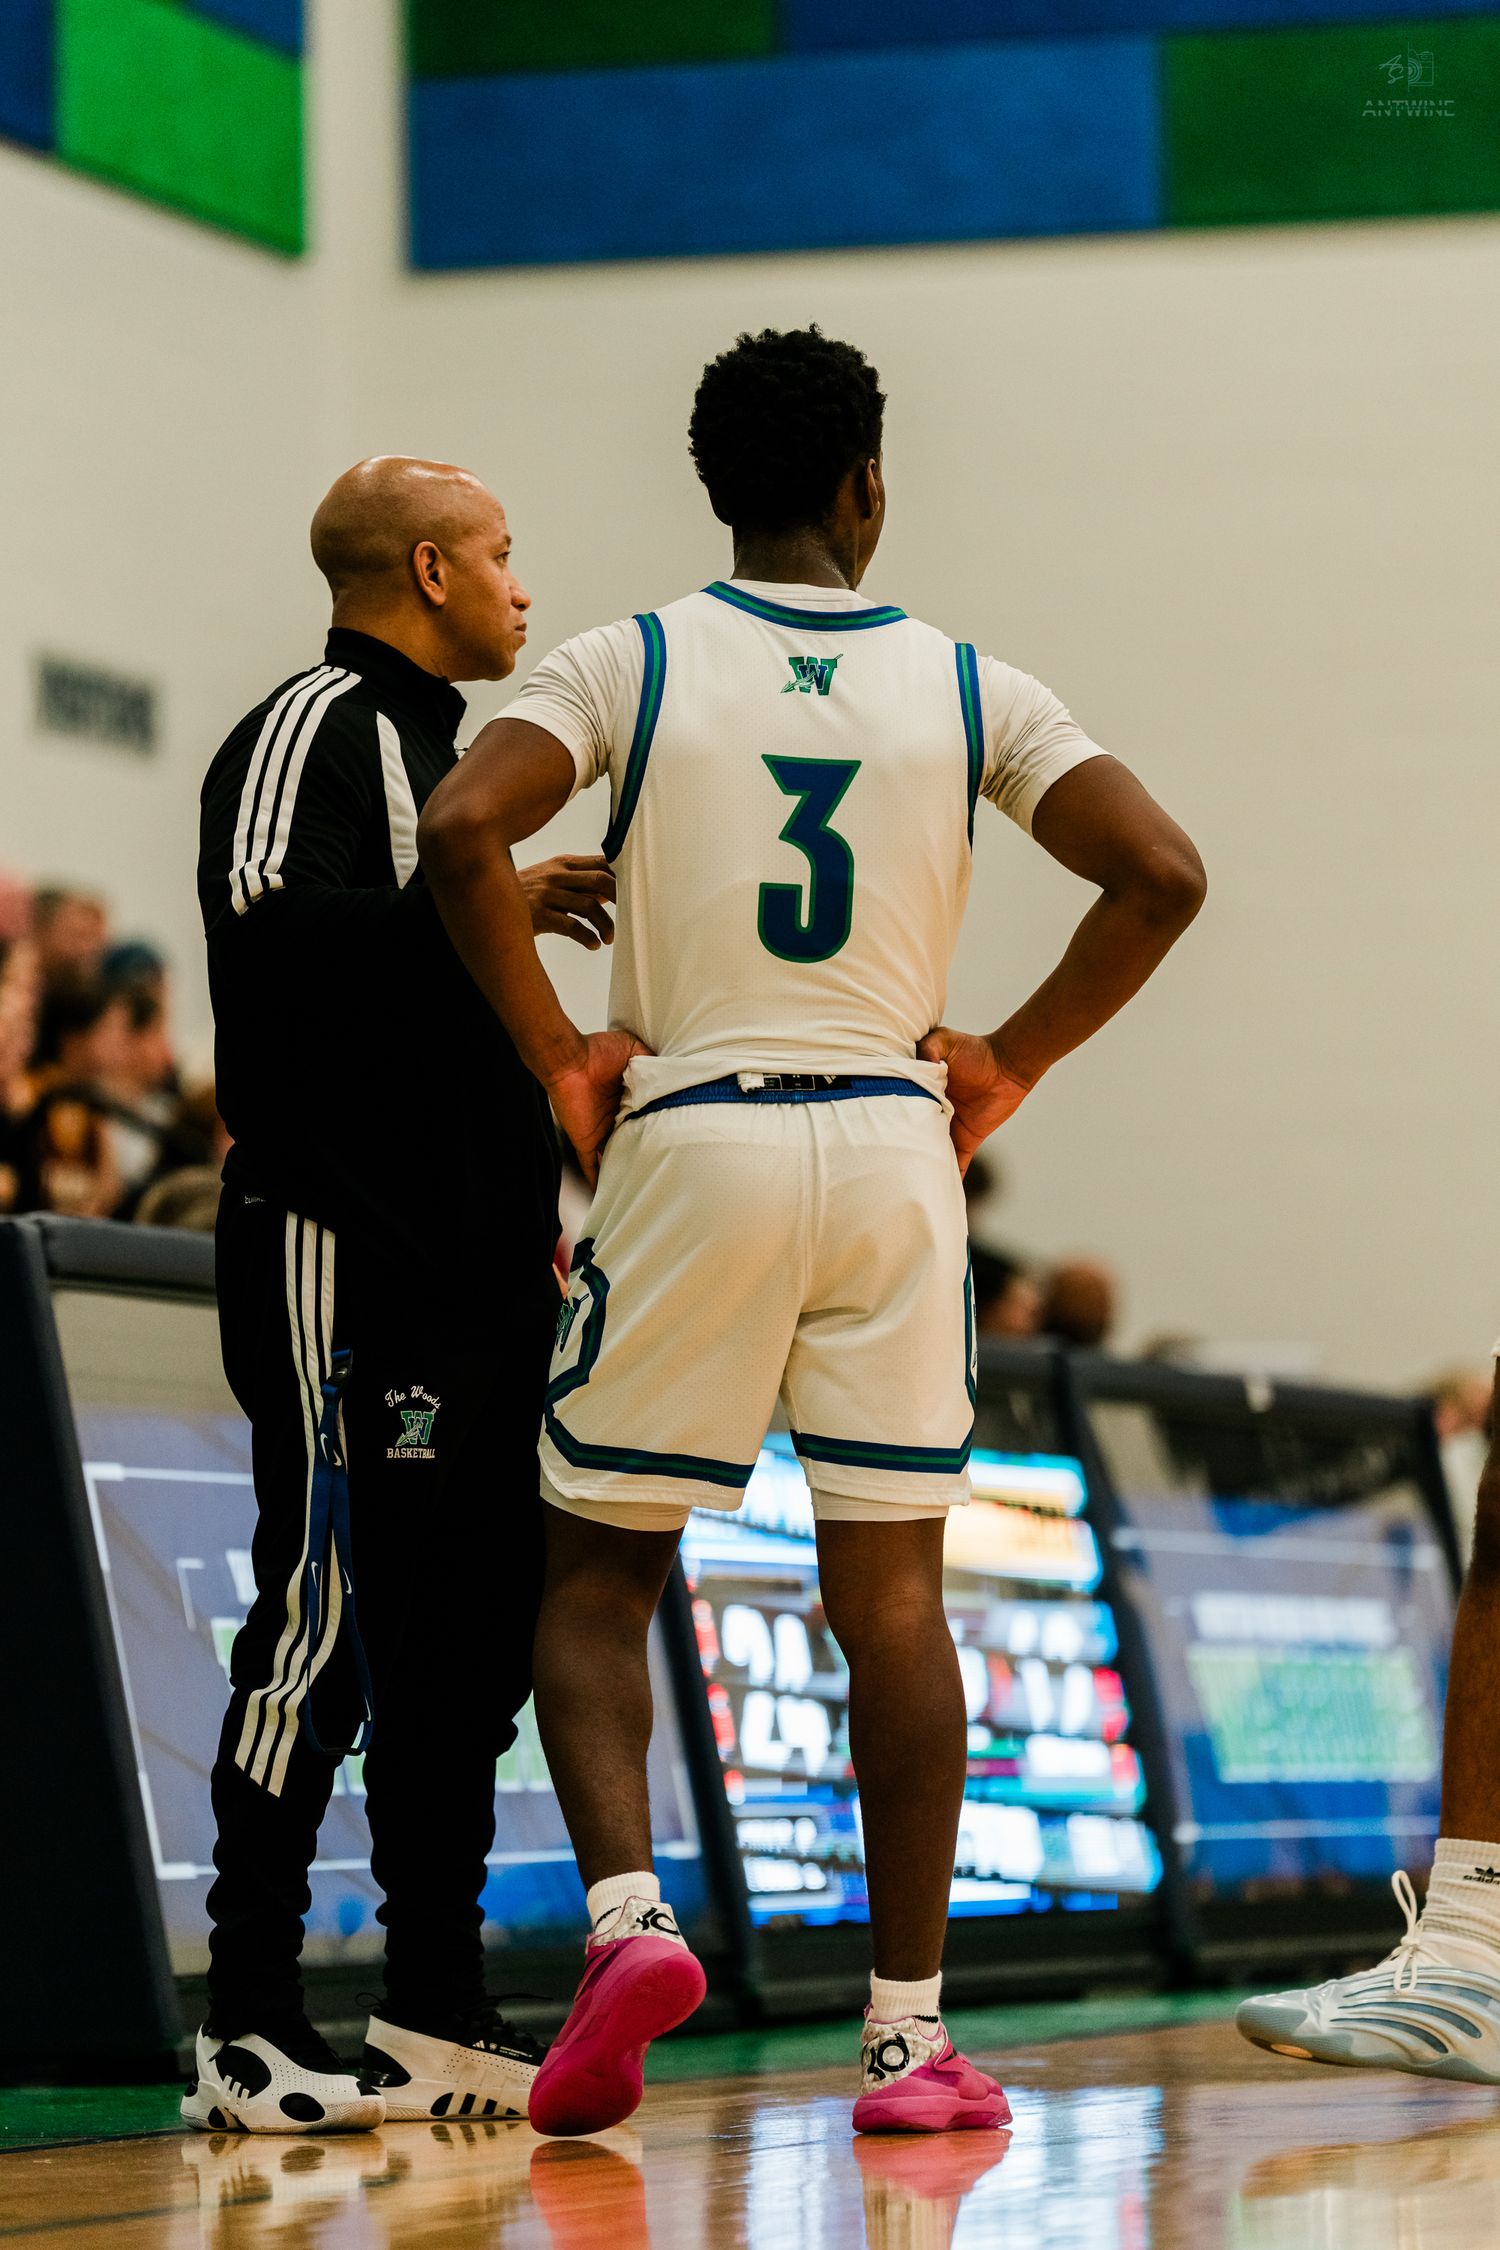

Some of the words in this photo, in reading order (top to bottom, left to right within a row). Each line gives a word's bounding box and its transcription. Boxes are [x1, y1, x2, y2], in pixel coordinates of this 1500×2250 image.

[757, 754, 862, 964] 3
[385, 1389, 406, 1407] The
[411, 1385, 441, 1409] Woods
[386, 1447, 436, 1459] BASKETBALL
[1463, 1874, 1500, 1885] adida
